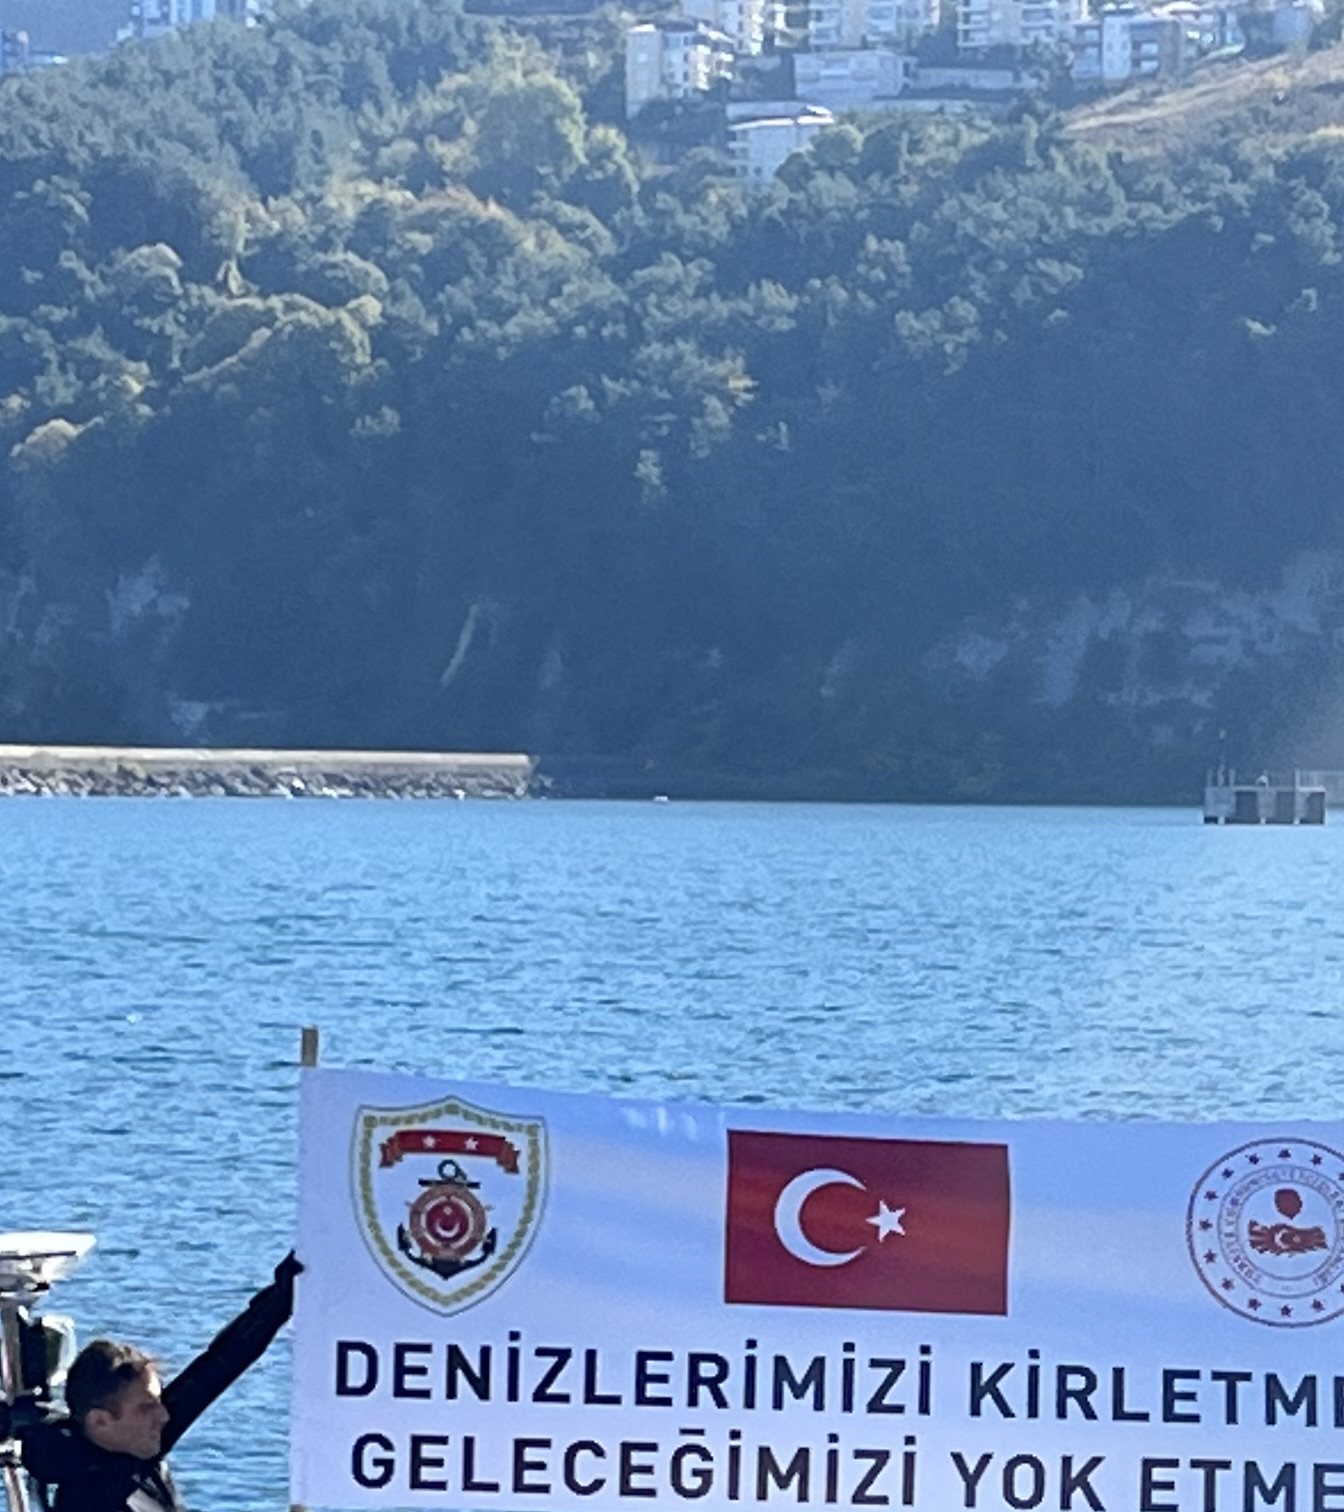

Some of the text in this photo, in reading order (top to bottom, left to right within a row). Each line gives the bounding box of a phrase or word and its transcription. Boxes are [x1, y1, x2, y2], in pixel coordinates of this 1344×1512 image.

[335, 1330, 932, 1417] DENİZLERİMİZİ
[351, 1428, 917, 1506] GELECEĞİMİZİ
[950, 1452, 1106, 1512] YOK
